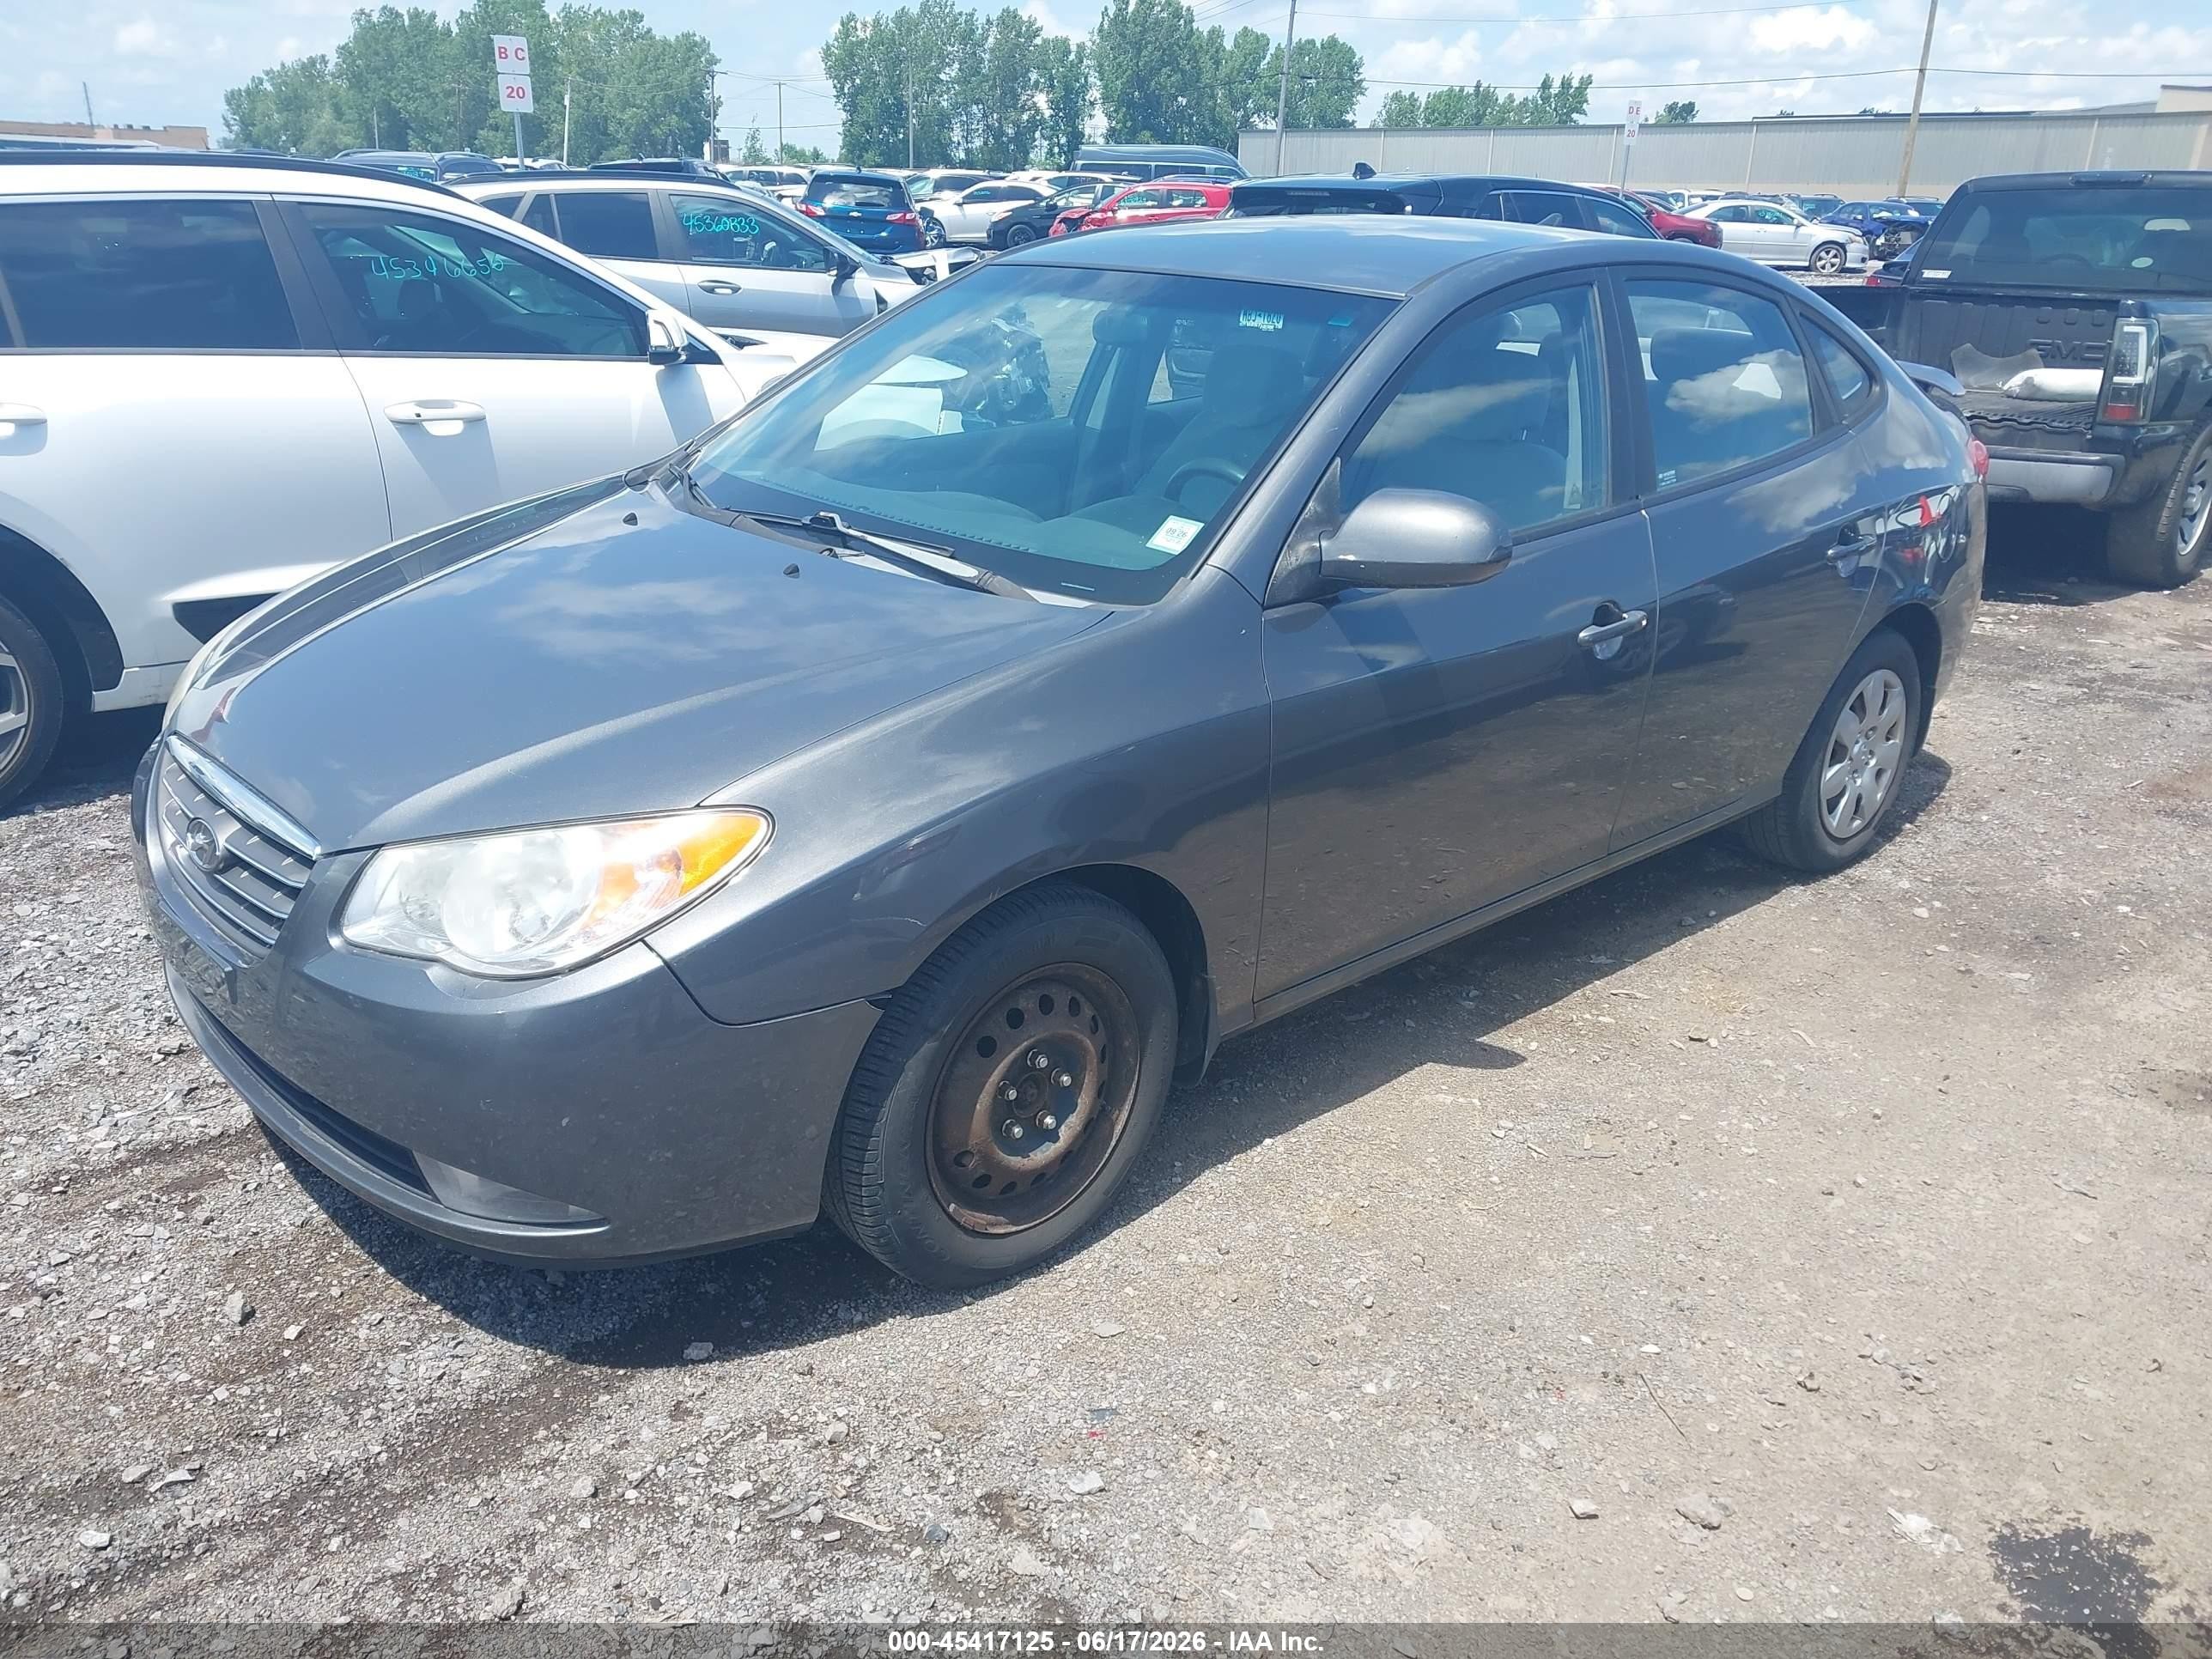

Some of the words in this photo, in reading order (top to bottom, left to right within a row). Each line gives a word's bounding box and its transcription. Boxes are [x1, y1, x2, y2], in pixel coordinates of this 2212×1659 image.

[498, 46, 508, 59] B
[515, 47, 526, 61] C
[506, 86, 526, 99] 20
[1628, 106, 1634, 114] D
[1636, 106, 1641, 115] E
[2028, 338, 2107, 360] GMC
